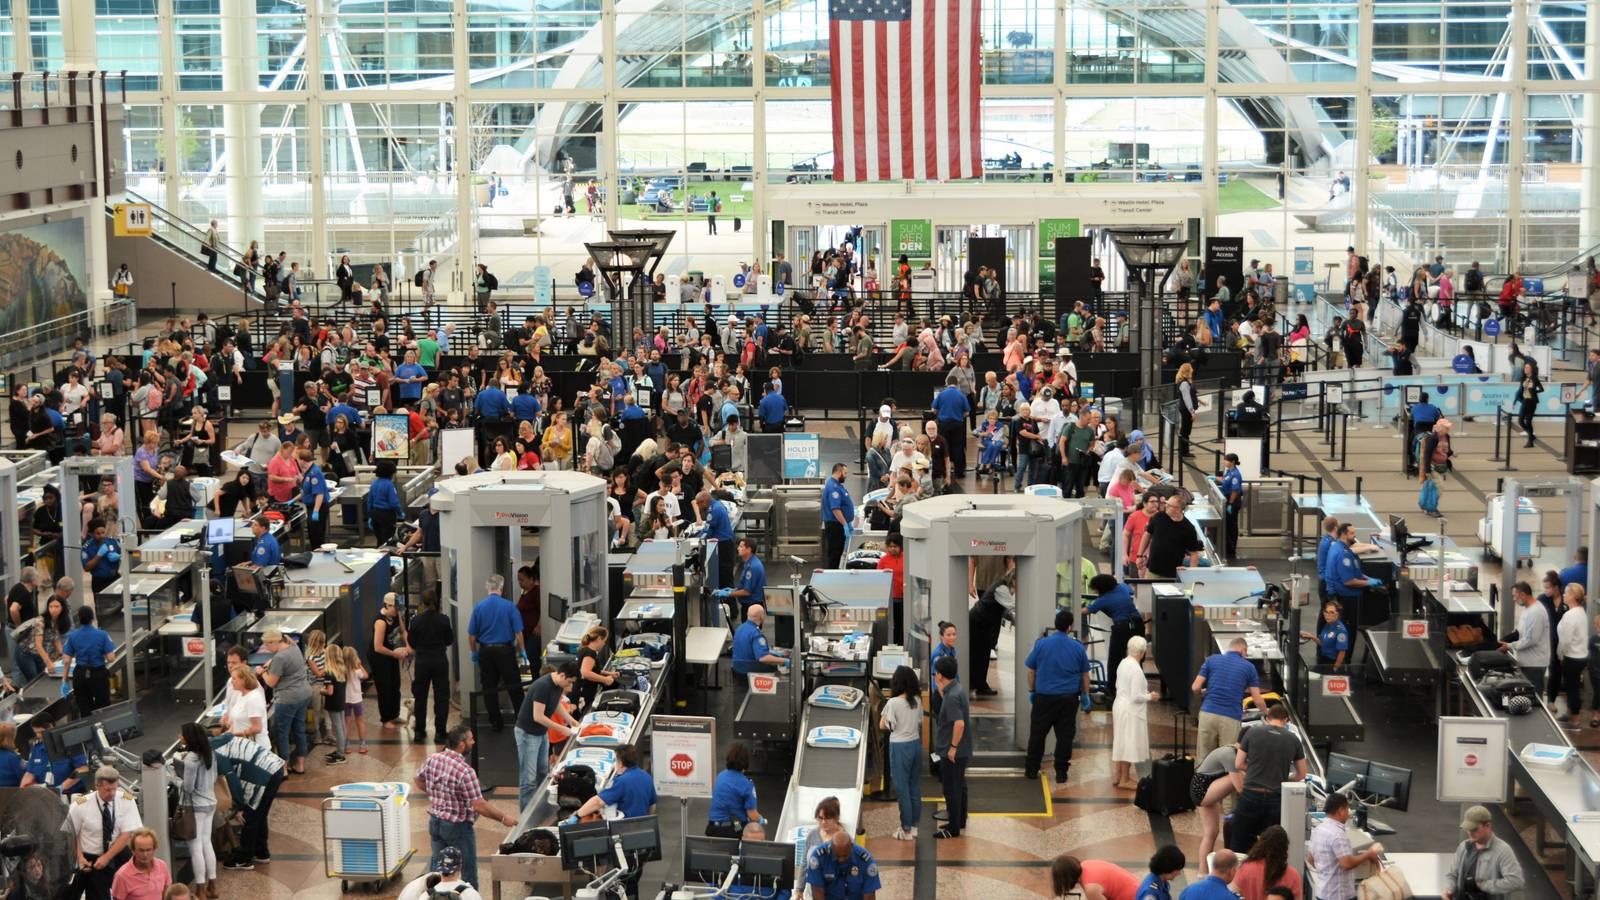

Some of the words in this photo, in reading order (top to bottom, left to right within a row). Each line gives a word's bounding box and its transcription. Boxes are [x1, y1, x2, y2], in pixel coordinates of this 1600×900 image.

[899, 241, 923, 251] DEN
[755, 679, 773, 687] STOP
[671, 760, 693, 770] STOP
